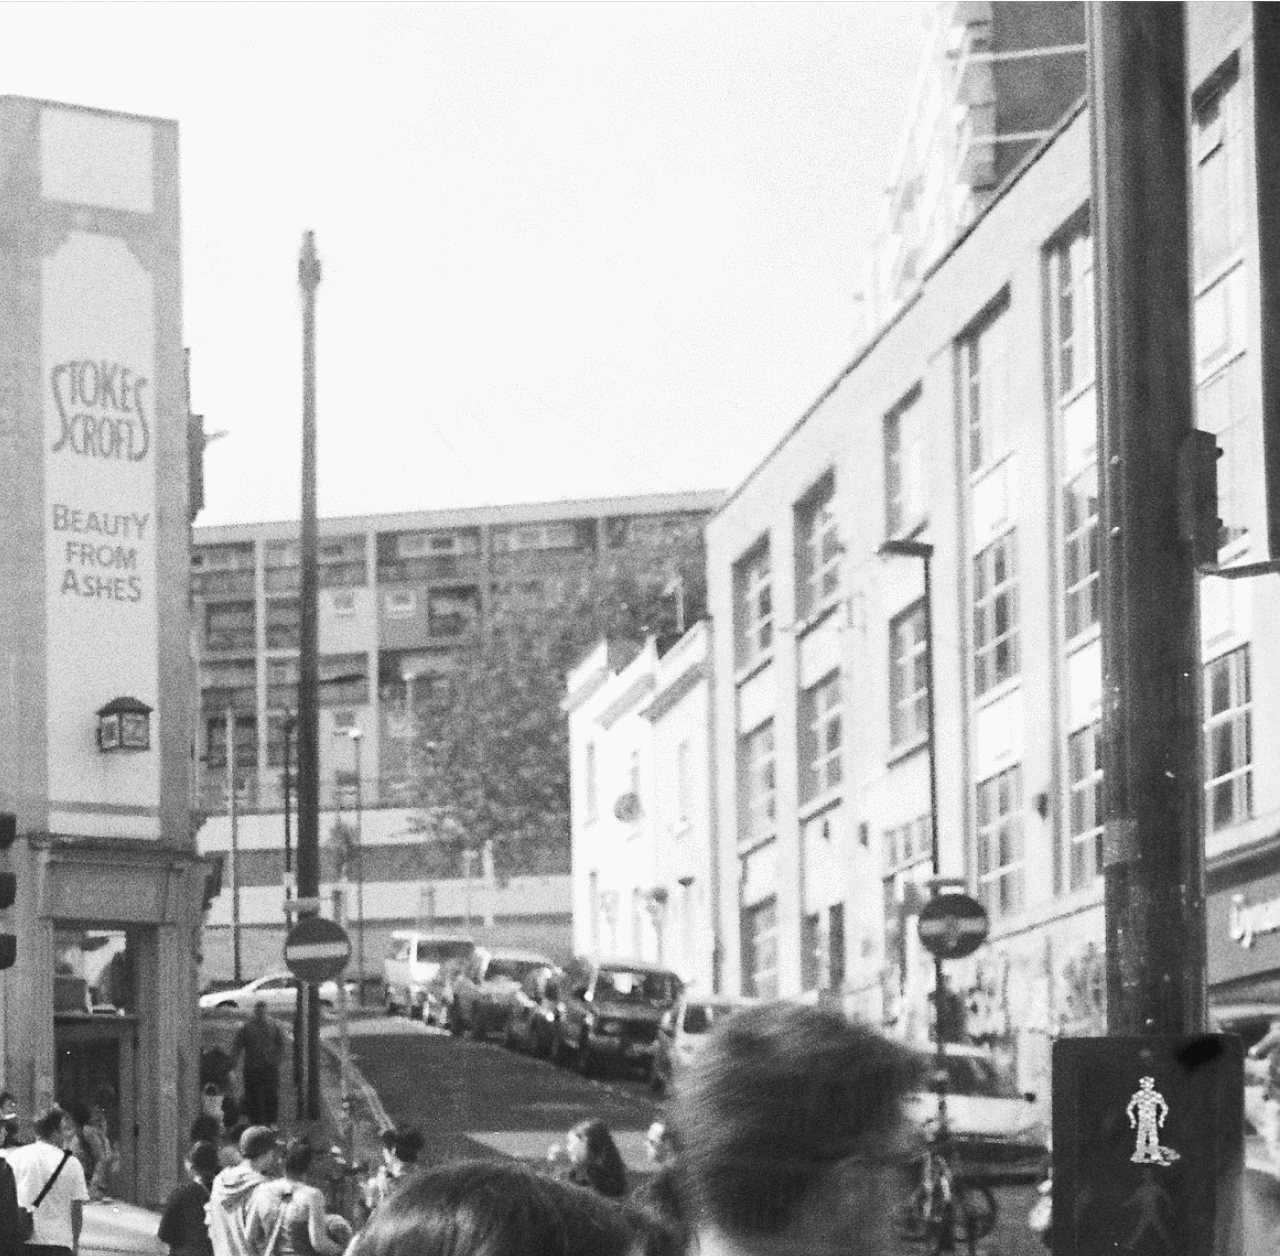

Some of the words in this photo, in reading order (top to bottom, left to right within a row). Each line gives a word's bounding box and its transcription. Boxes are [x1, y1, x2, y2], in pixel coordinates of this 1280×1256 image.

[52, 504, 149, 540] BEAUTY
[66, 542, 137, 570] FROM
[61, 570, 142, 602] ASHES
